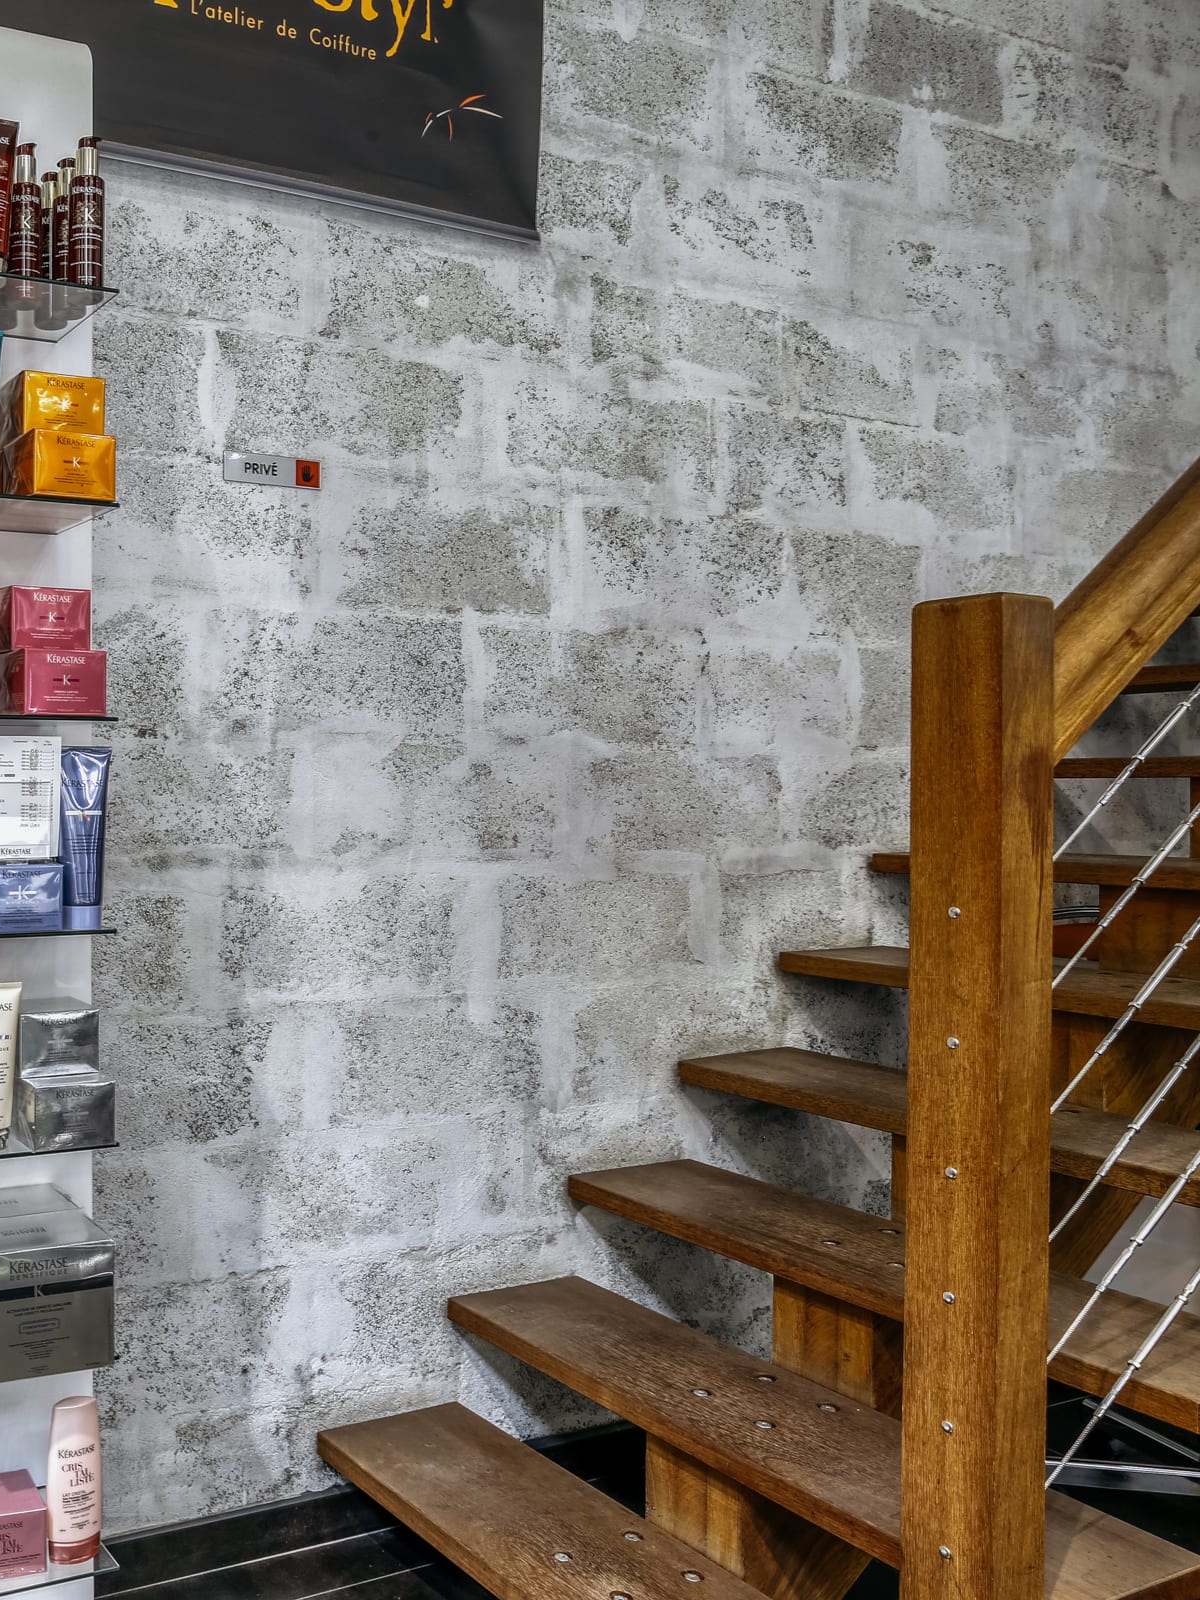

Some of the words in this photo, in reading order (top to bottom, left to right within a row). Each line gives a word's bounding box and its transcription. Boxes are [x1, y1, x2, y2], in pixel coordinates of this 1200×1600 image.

[190, 1, 263, 30] L'atelier
[276, 19, 298, 39] de
[309, 27, 377, 61] Coiffure
[244, 462, 278, 476] PRIVÉ
[33, 592, 72, 603] KÉRASTASE
[46, 653, 86, 665] KÉRASTASE
[0, 847, 31, 856] KÉRASTASE
[9, 1256, 69, 1275] KÉRASTASE
[10, 1269, 69, 1281] DENSIFIQUE
[57, 1443, 96, 1459] KÉRASTASE
[61, 1463, 84, 1473] CRIS
[70, 1475, 96, 1488] LISTE
